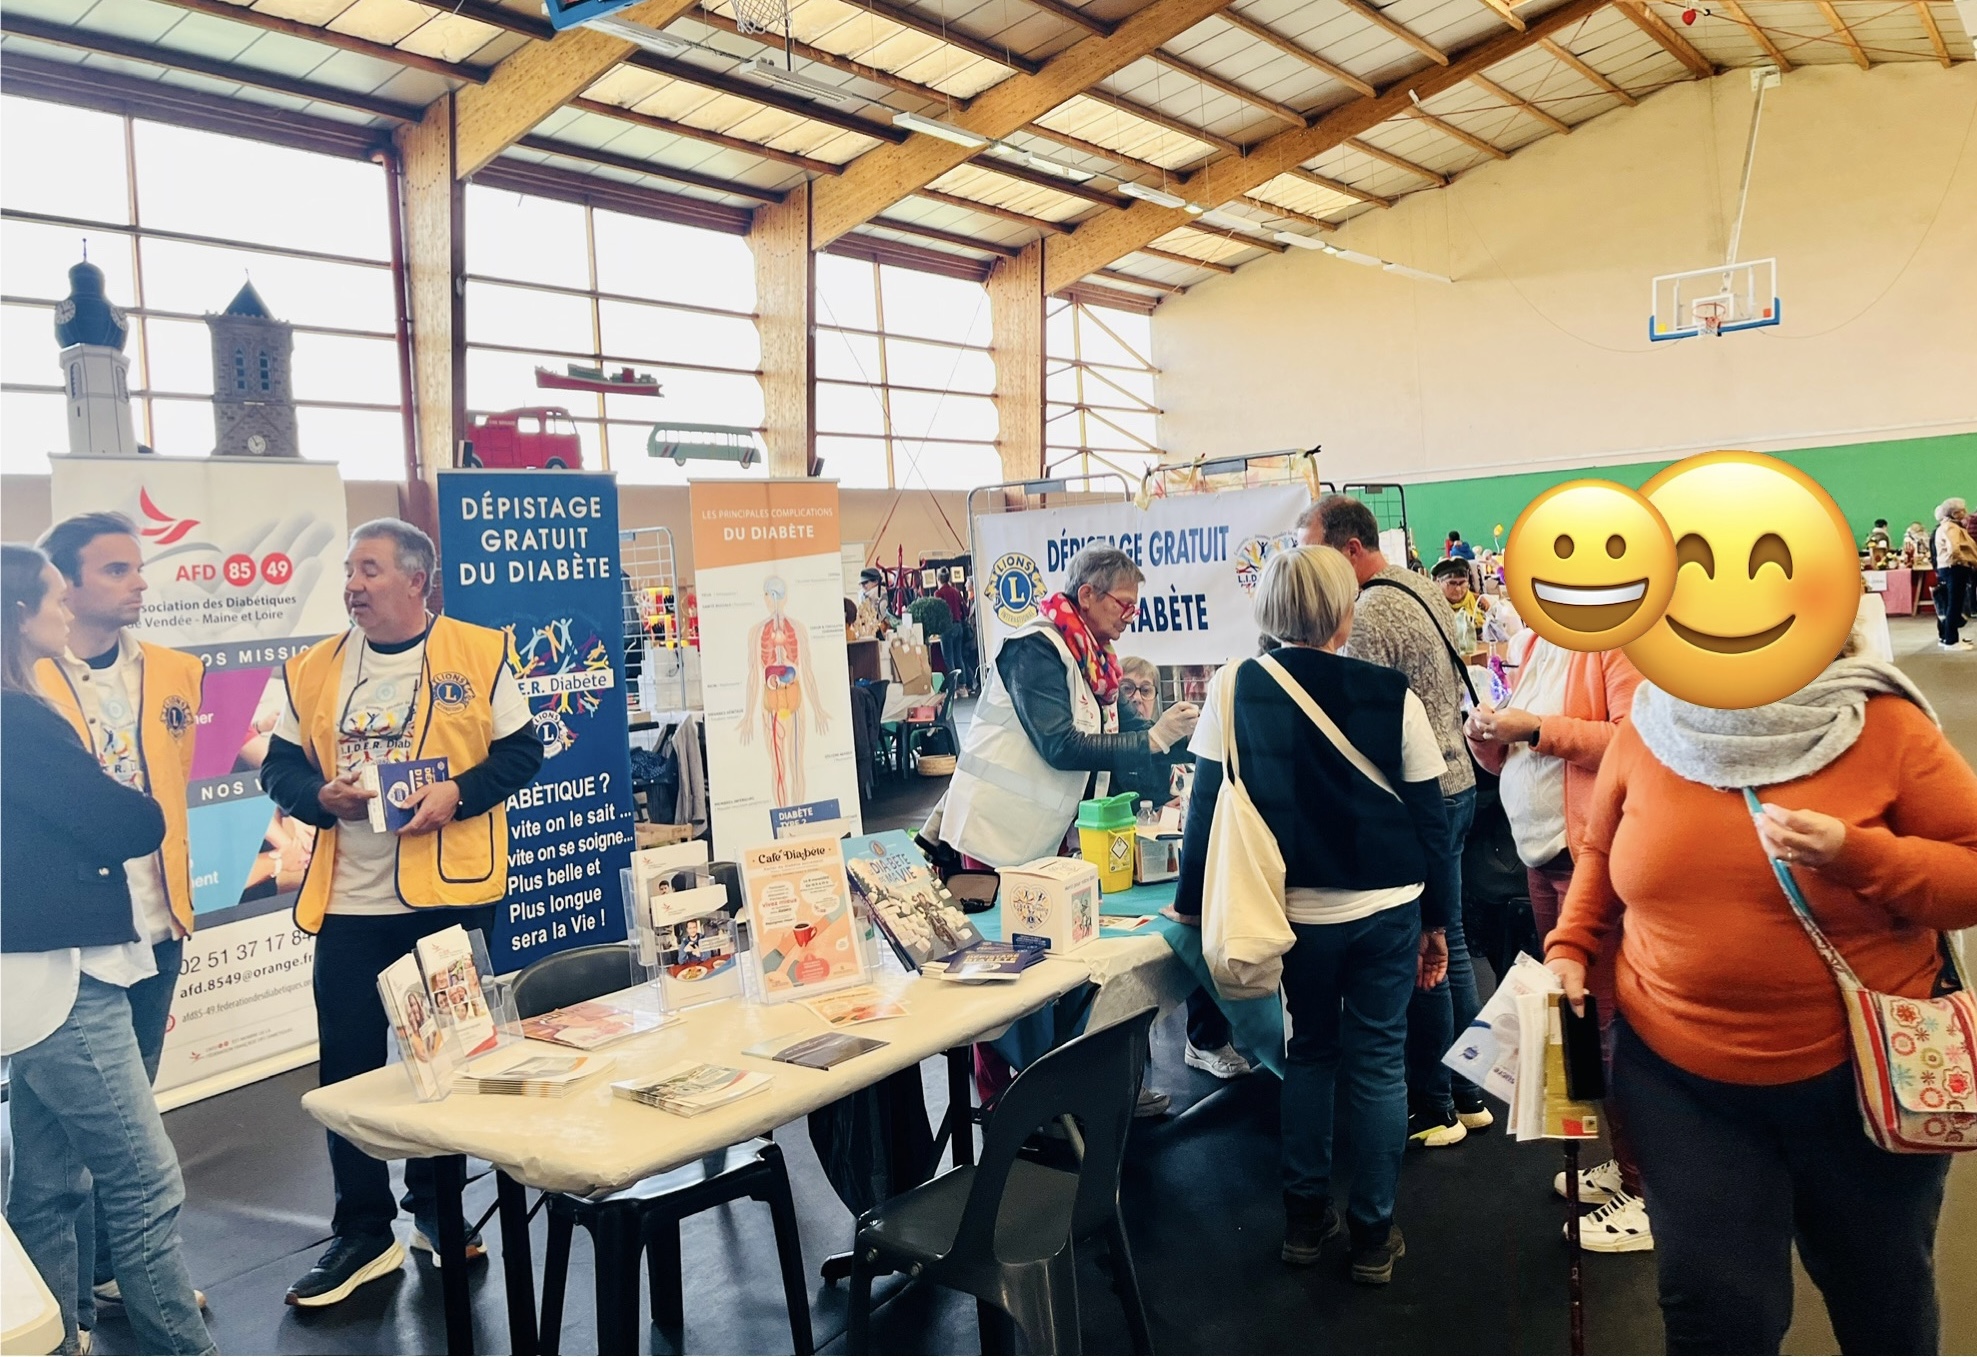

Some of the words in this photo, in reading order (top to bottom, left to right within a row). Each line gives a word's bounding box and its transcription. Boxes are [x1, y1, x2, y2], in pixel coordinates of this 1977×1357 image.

[461, 490, 601, 520] DÉPISTAGE
[702, 510, 717, 520] LES
[718, 508, 769, 519] PRINCIPALES
[771, 507, 833, 518] COMPLICATIONS
[481, 527, 588, 552] GRATUIT
[723, 526, 745, 541] DU
[1047, 528, 1143, 573] DÉPGE
[1149, 525, 1229, 567] GRATUIT
[176, 564, 216, 582] AFD
[228, 562, 250, 579] 85
[267, 560, 288, 577] 49
[459, 562, 495, 586] DU
[508, 551, 610, 583] DIABÈTE
[996, 556, 1032, 573] LIONS
[1008, 576, 1026, 603] L
[203, 599, 223, 610] des
[226, 594, 297, 608] Diabétiques
[145, 612, 192, 628] Vendée
[202, 610, 238, 625] Maine
[241, 611, 252, 622] et
[255, 607, 284, 621] Loire
[436, 673, 466, 683] LIONS
[550, 673, 607, 692] Diabète
[445, 685, 457, 700] L
[534, 712, 558, 723] LIONS
[542, 724, 554, 742] L
[201, 781, 244, 801] NOS
[599, 772, 611, 793] ?
[511, 820, 541, 840] vite
[545, 816, 565, 833] on
[569, 810, 583, 828] le
[587, 803, 615, 824] sait
[507, 849, 534, 867] vite
[537, 844, 556, 861] on
[559, 841, 575, 857] se
[578, 830, 633, 852] soigne...
[758, 849, 782, 864] Café
[508, 873, 543, 896] Plus
[547, 863, 583, 886] belle
[586, 857, 601, 875] et
[895, 866, 917, 883] VIE
[509, 901, 545, 924] Plus
[550, 887, 602, 914] longue
[511, 929, 548, 951] sera
[552, 921, 567, 939] la
[570, 914, 596, 934] Vie
[600, 908, 606, 926] !
[208, 949, 228, 968] 51
[236, 940, 258, 961] 37
[265, 933, 285, 952] 17
[180, 952, 313, 998] afd.8549@orange.fr
